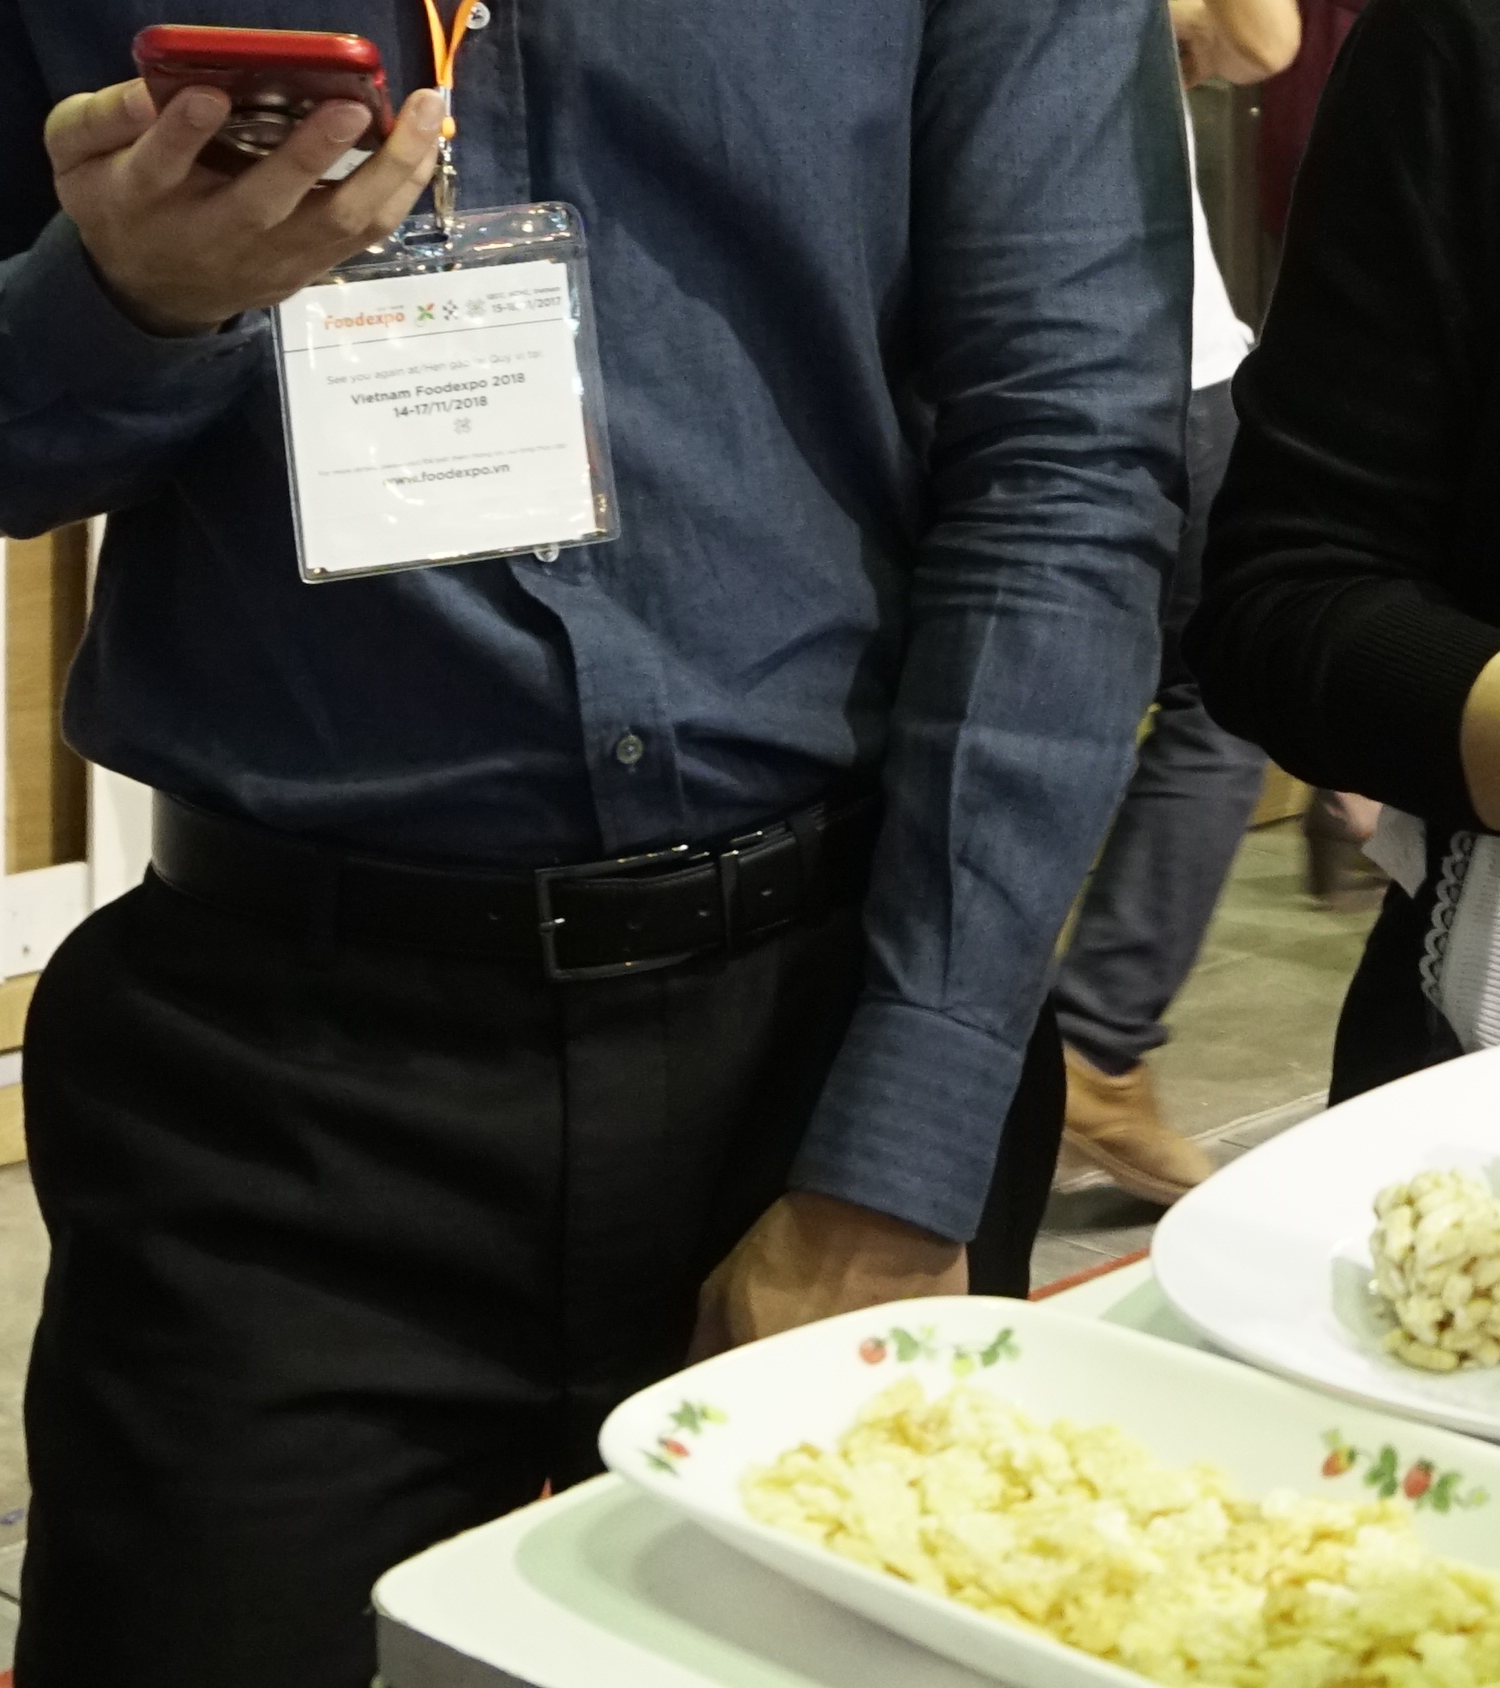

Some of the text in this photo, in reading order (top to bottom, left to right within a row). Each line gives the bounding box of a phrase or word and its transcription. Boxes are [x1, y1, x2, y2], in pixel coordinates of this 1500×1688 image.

[323, 309, 406, 331] Foodexpo
[350, 372, 526, 405] Vietnam Foodexpo 2018
[393, 395, 489, 418] 14-17/11/2018
